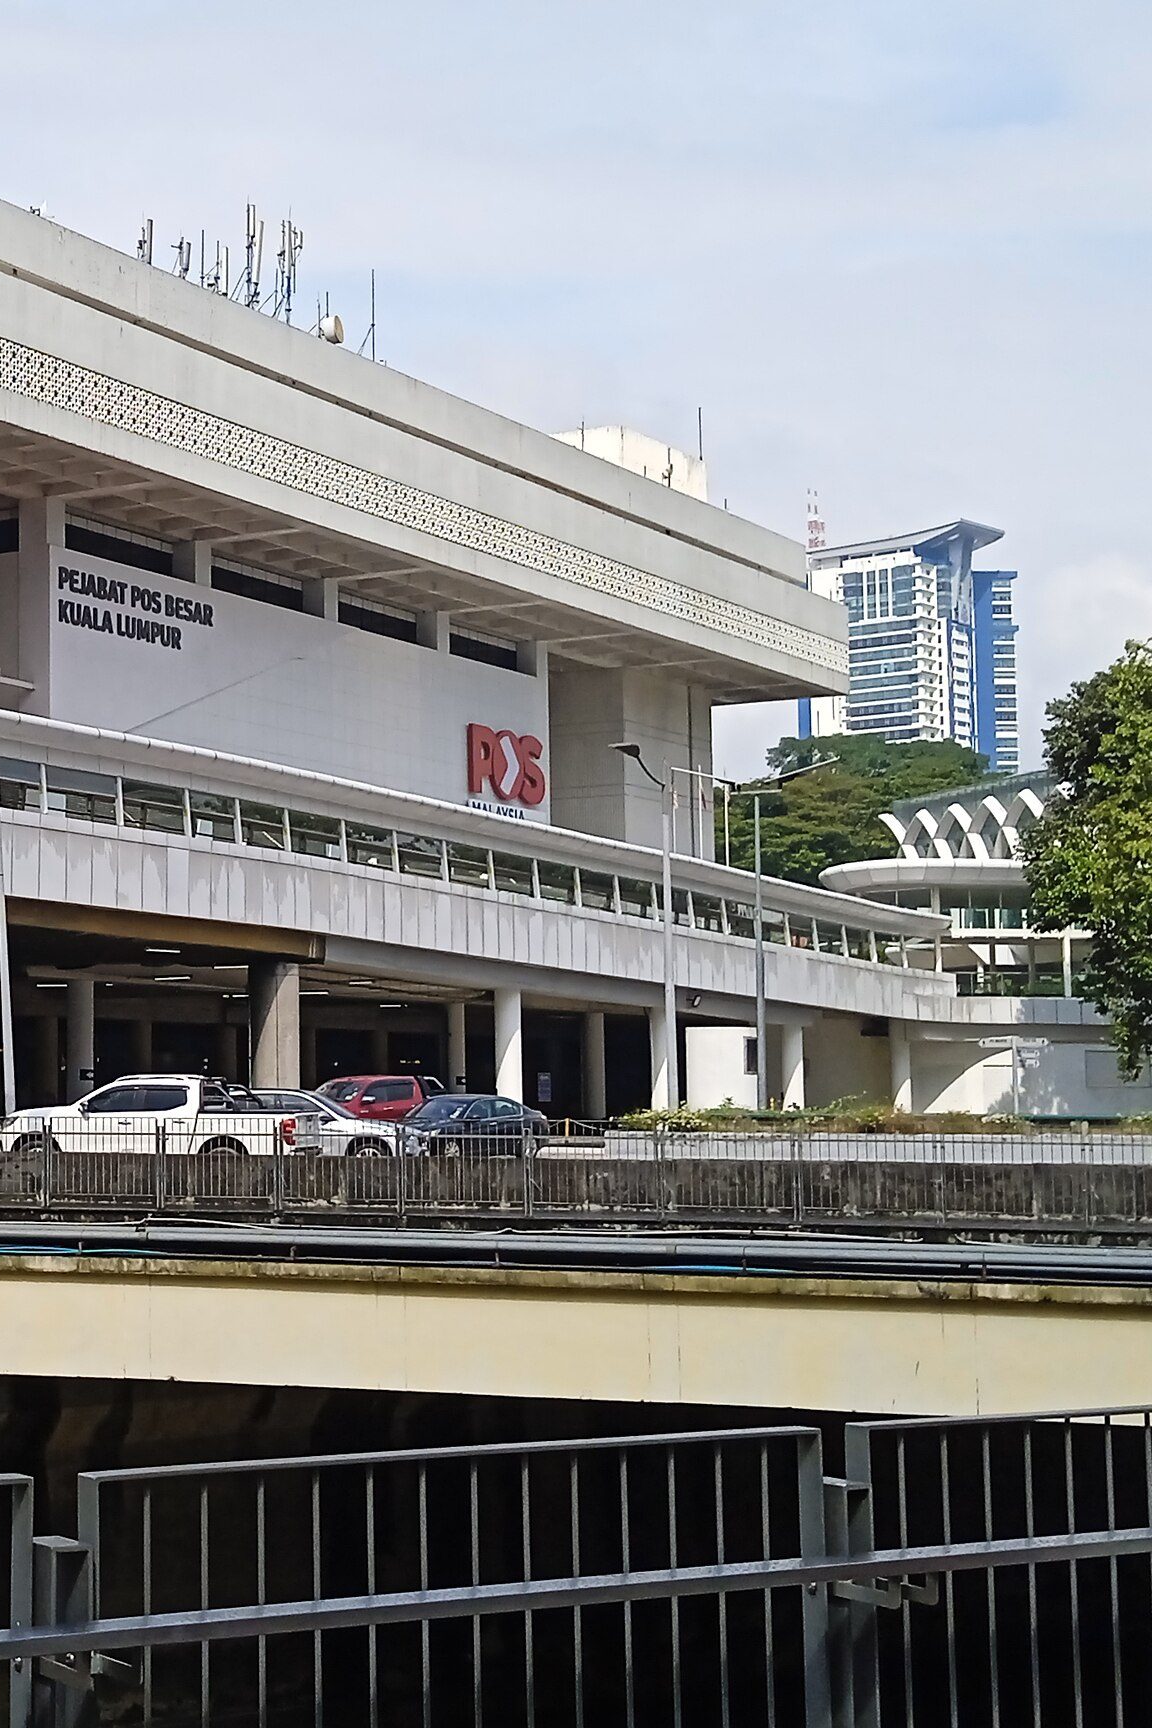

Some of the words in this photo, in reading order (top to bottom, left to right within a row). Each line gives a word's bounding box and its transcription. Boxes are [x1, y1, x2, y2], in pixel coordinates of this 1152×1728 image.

[57, 566, 128, 605] PEJABAT
[130, 585, 162, 614] POS
[164, 594, 214, 627] BESAR
[57, 598, 114, 634] KUALA
[116, 612, 182, 650] LUMPUR
[466, 722, 546, 806] POS
